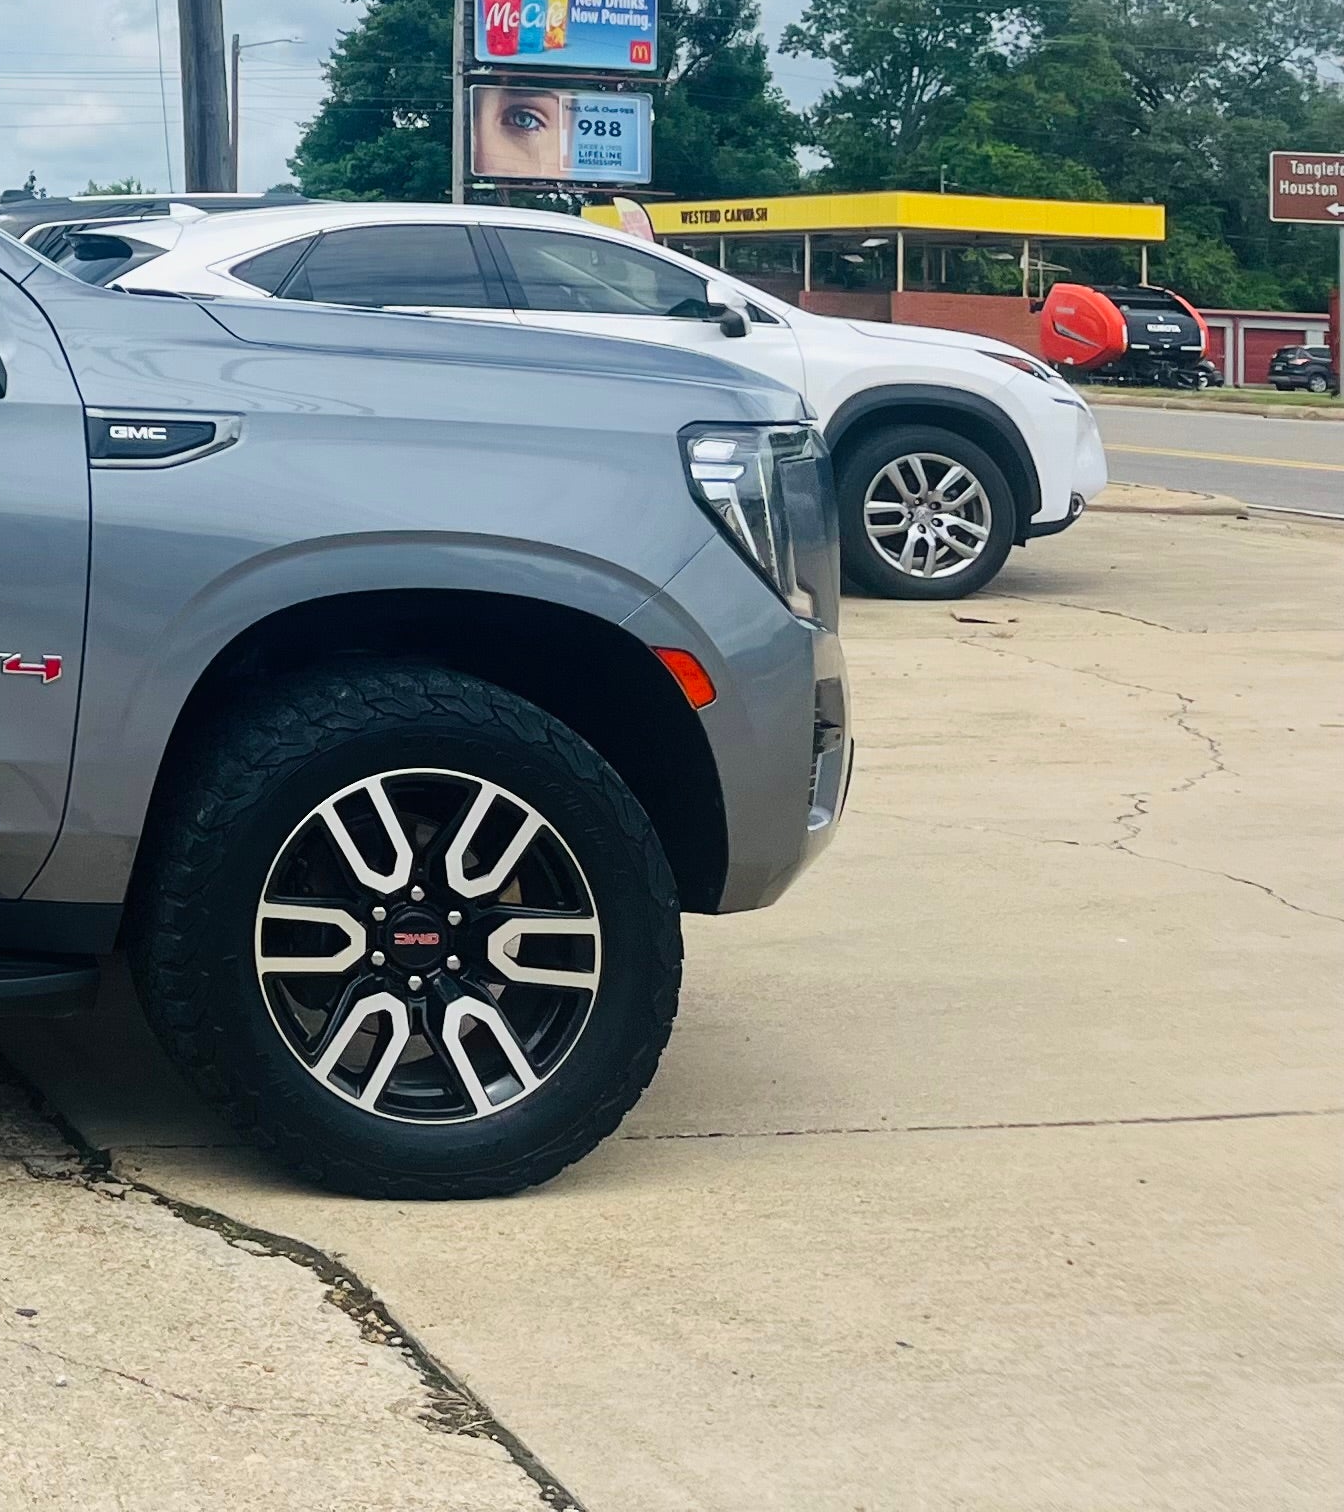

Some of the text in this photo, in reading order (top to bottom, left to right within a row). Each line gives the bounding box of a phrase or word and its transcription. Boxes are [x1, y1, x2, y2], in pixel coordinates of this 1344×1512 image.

[571, 7, 652, 31] Now Pouring.
[578, 119, 622, 137] 988
[578, 151, 622, 160] LIFELINE
[1279, 180, 1338, 196] Houston
[109, 425, 167, 440] GMC
[393, 933, 440, 945] GMC
